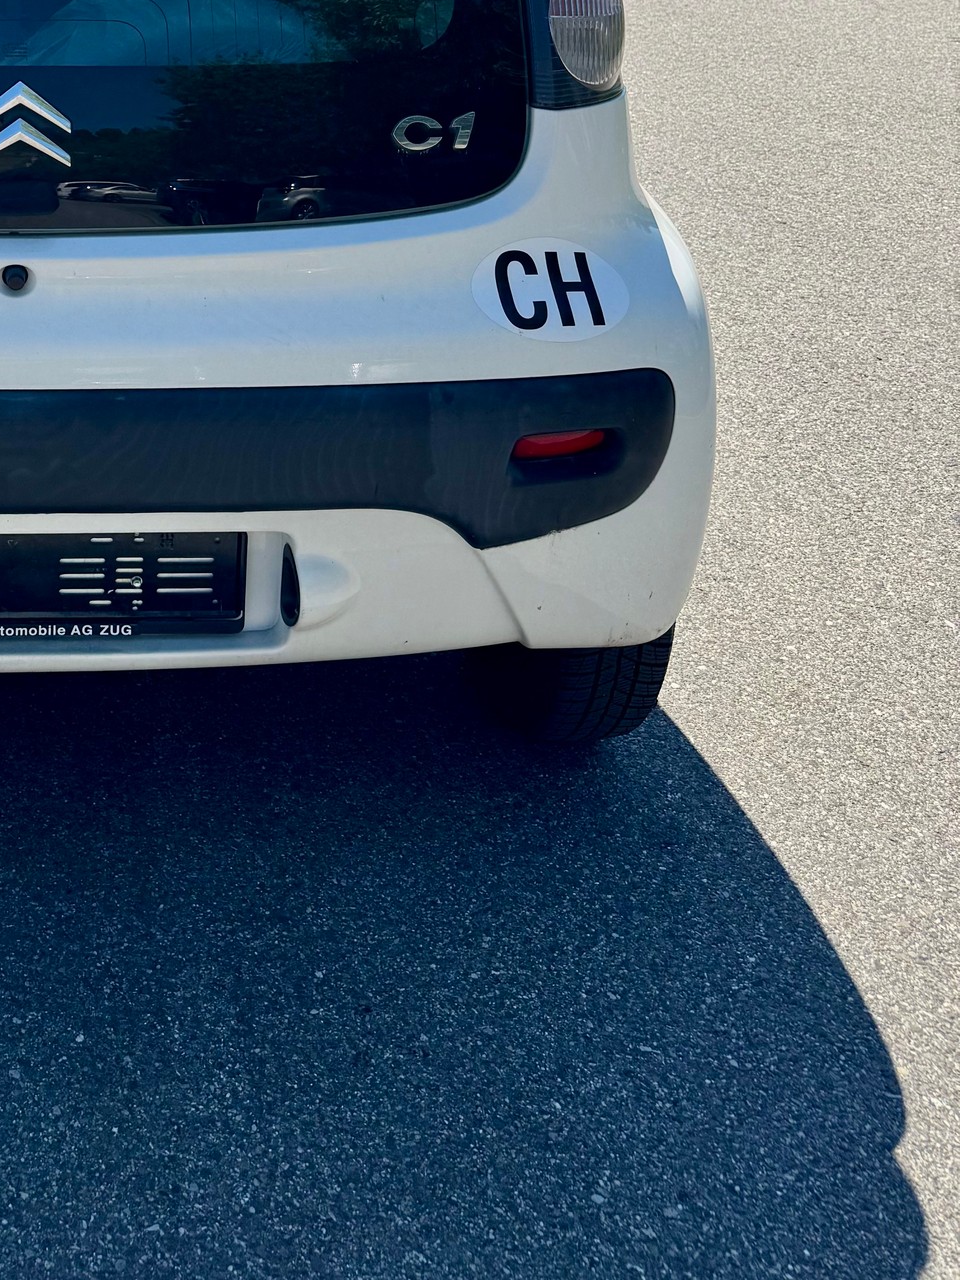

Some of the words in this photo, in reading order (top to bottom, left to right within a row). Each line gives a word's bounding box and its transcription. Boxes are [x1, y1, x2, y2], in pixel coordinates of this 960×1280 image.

[392, 111, 476, 151] C1
[494, 250, 607, 331] CH
[70, 624, 93, 636] AG
[99, 624, 132, 636] ZUG
